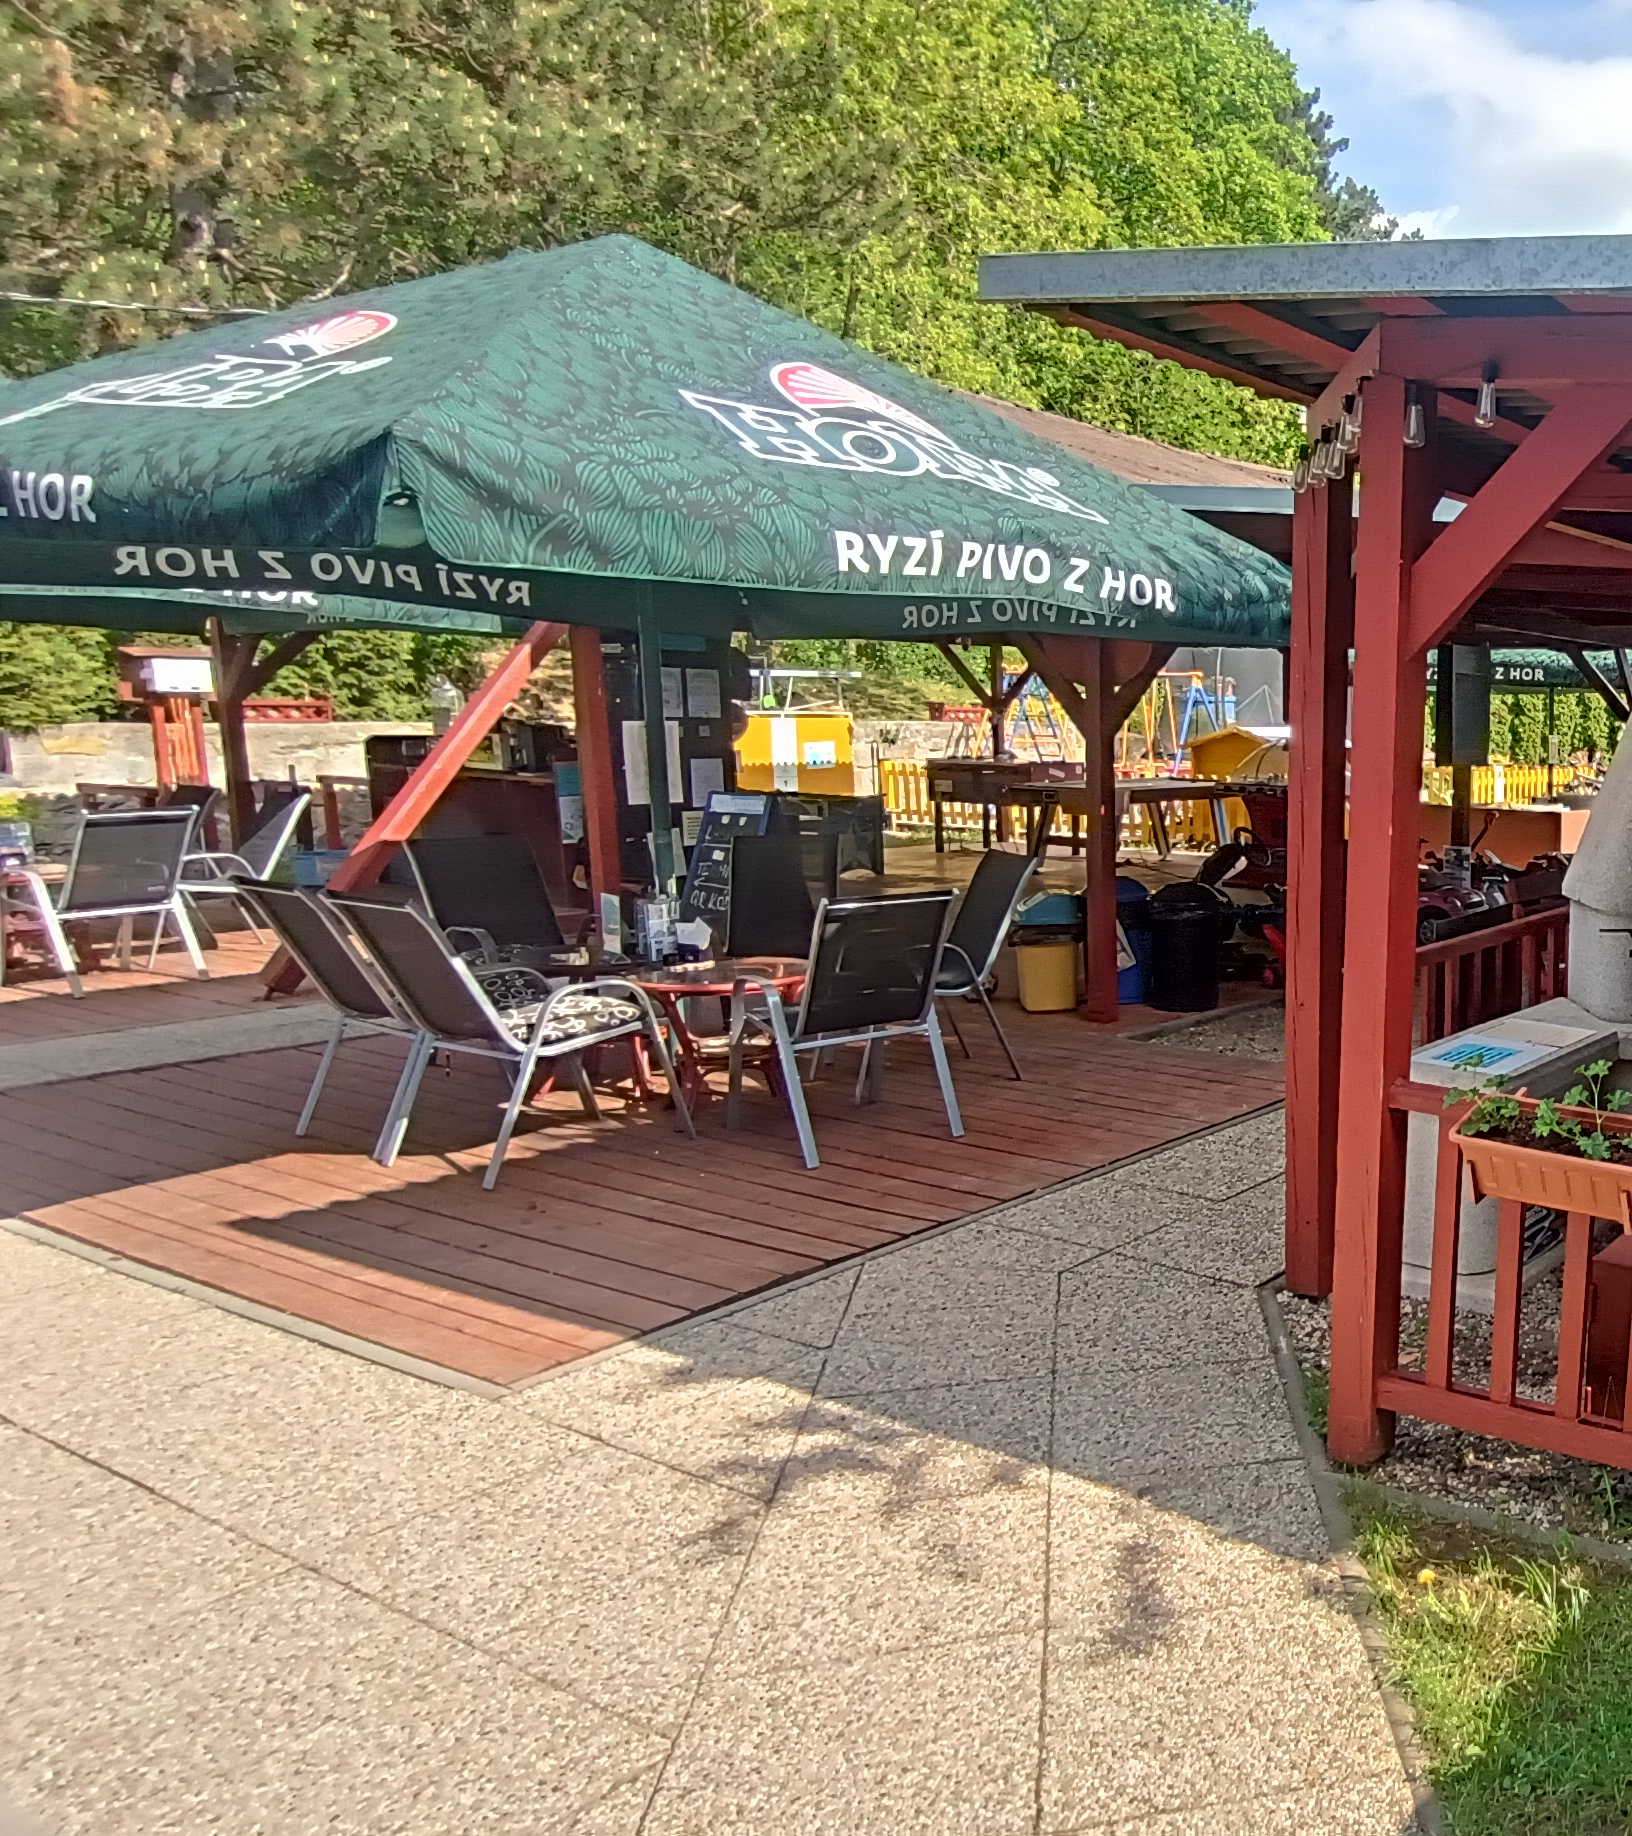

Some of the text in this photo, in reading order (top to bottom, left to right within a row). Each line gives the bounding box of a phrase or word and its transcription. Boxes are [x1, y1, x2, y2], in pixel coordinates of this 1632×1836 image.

[12, 470, 97, 523] HOR
[834, 529, 1177, 613] RYZÍ PIVO Z HOR
[1494, 666, 1545, 682] Z HOR
